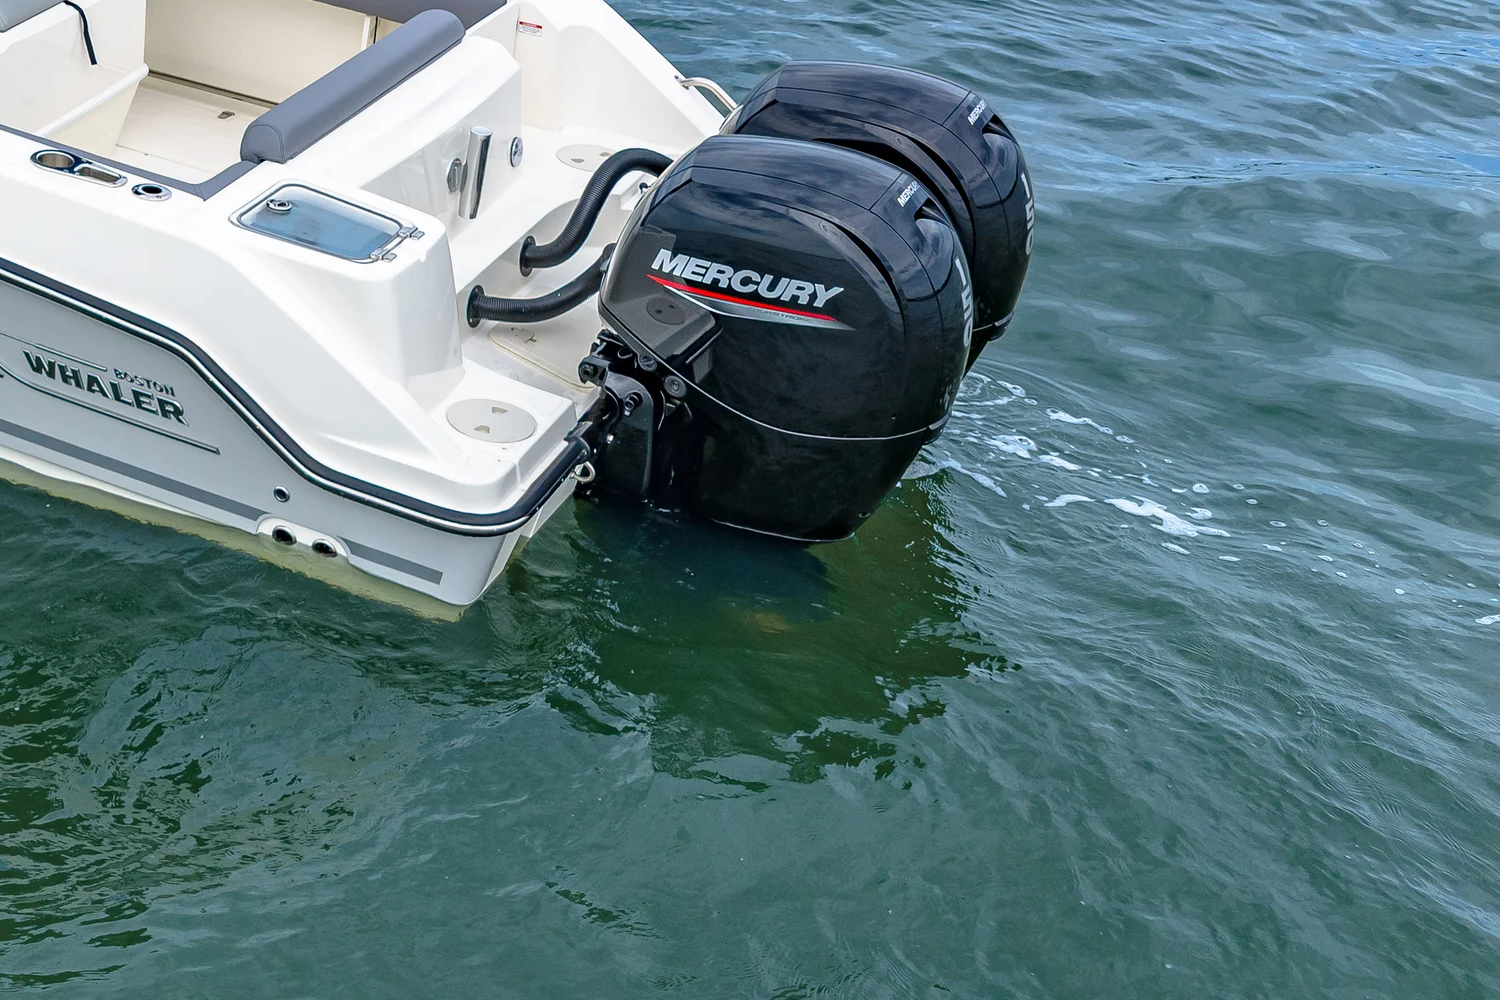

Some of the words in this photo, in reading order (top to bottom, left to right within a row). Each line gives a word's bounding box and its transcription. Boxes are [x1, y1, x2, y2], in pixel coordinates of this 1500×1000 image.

[651, 248, 845, 308] MERCURY
[22, 348, 190, 427] WHALER
[113, 368, 176, 398] BOSTON
